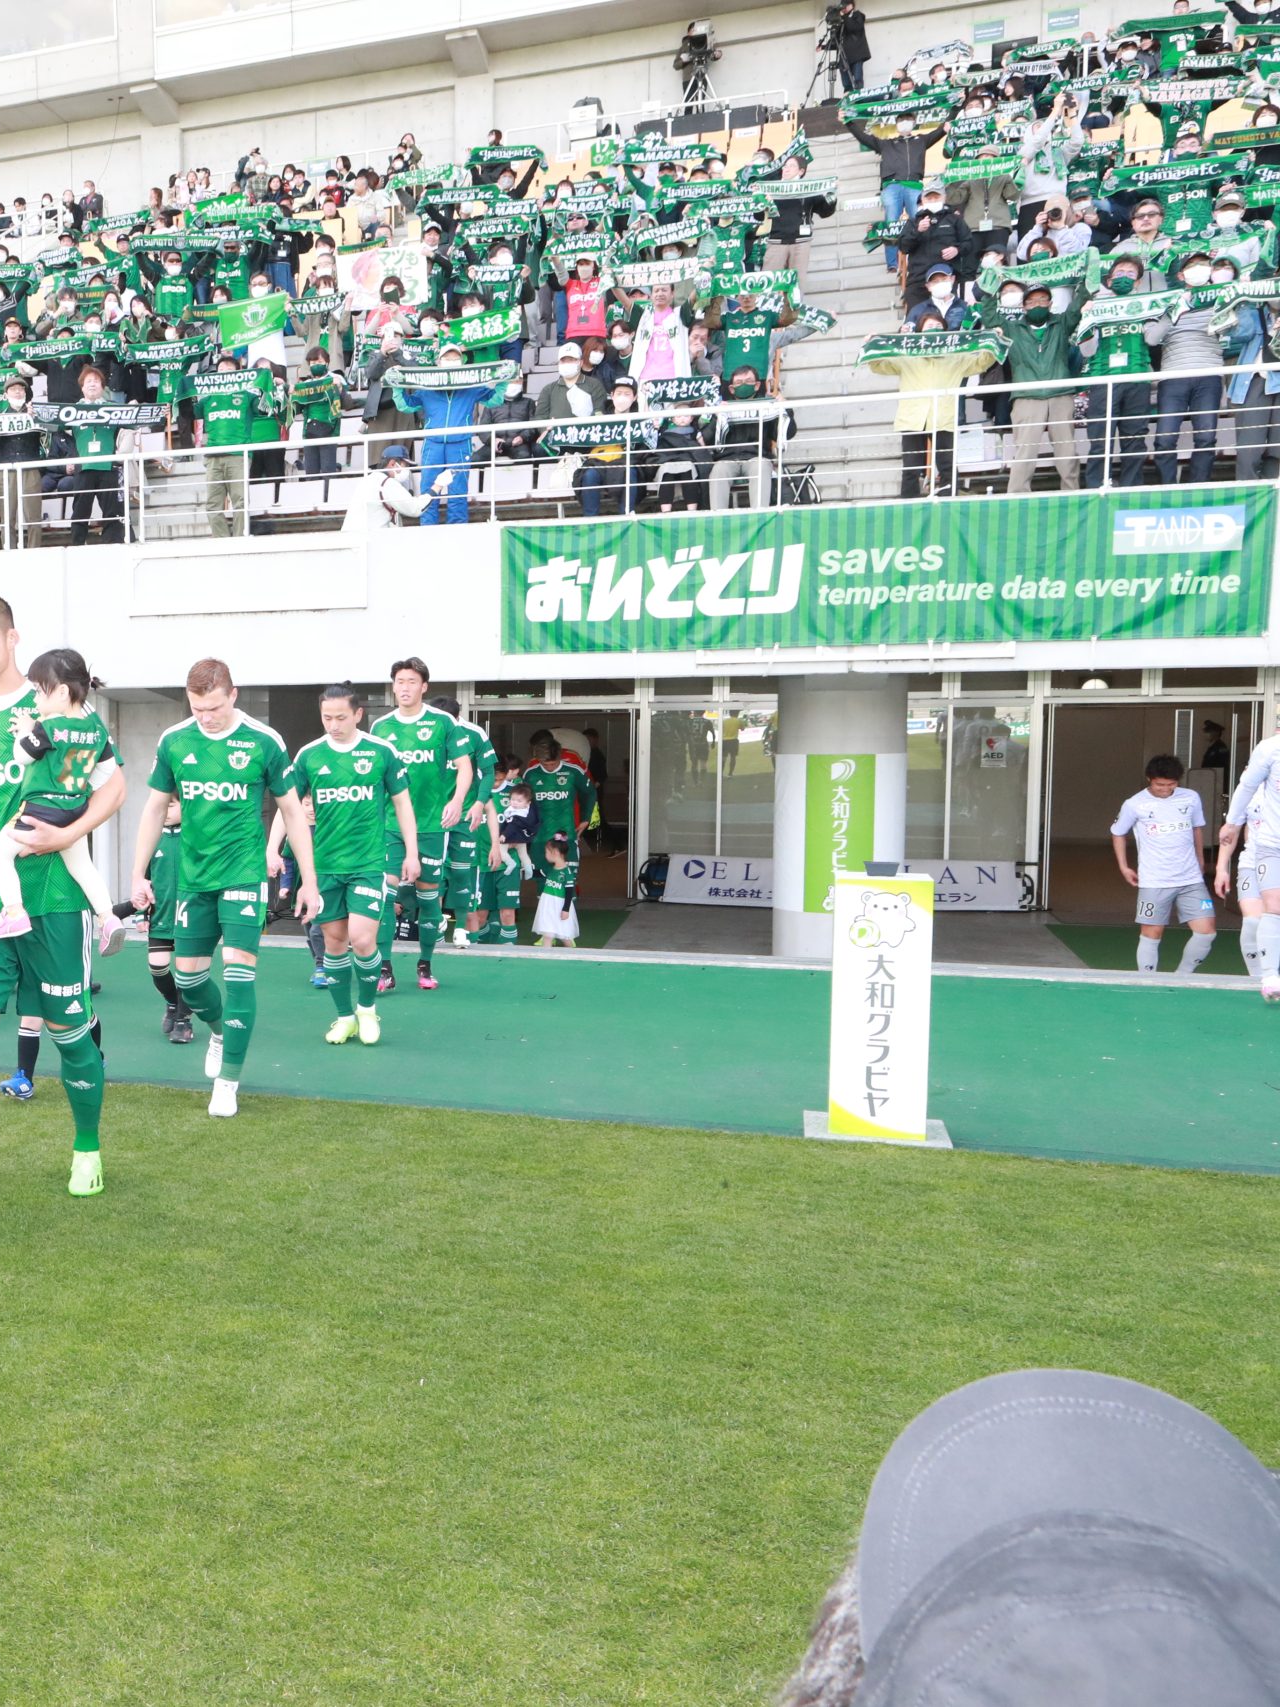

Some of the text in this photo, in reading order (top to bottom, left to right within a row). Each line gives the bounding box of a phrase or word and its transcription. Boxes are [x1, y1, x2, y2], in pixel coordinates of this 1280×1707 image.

[1151, 89, 1207, 102] YAMAGA
[631, 150, 682, 162] YAMAGA
[1168, 190, 1208, 203] EPSON
[463, 225, 505, 236] AMAGA
[550, 239, 602, 254] YAMAGA
[728, 329, 766, 339] EPSON
[21, 344, 68, 358] Yamaga
[742, 340, 751, 352] 3
[135, 347, 182, 360] YAMAGA
[194, 371, 257, 386] MATSUMOTO
[405, 372, 448, 385] MATSUMOTO
[450, 370, 479, 384] YAMAGA
[196, 382, 240, 395] YAMAGA
[209, 410, 241, 421] EPSON
[818, 544, 946, 576] saves
[525, 543, 806, 622] おんどとり
[818, 570, 1241, 609] temperature data every time
[11, 707, 39, 716] RAZUS
[227, 740, 255, 748] RAZUSO
[398, 749, 434, 763] PSON
[181, 781, 248, 802] EPSON
[316, 785, 374, 803] EPSON
[536, 791, 568, 801] EPSON
[1258, 864, 1267, 881] 9
[545, 880, 562, 889] PSON
[1241, 877, 1251, 891] 6
[708, 886, 762, 899] 株式会社
[1139, 901, 1155, 917] 18
[863, 954, 896, 1118] 大和グラビヤ
